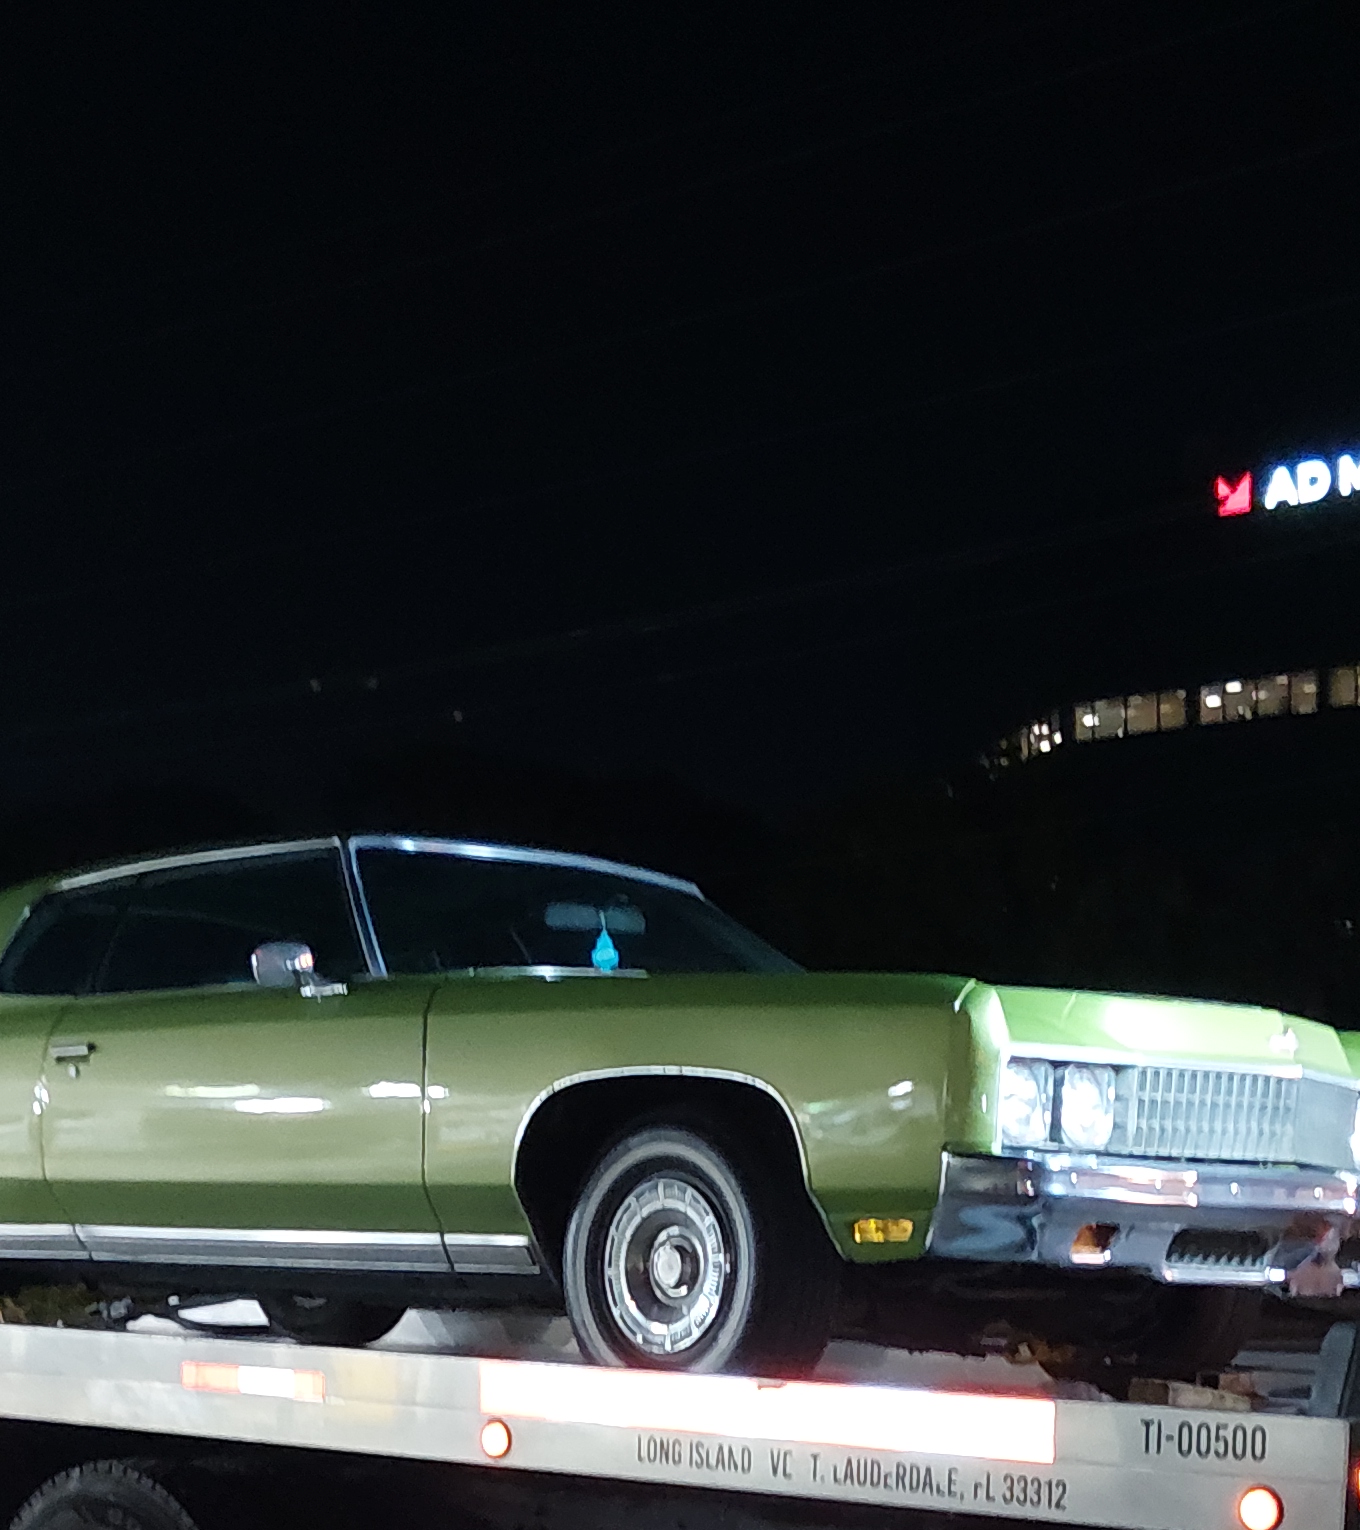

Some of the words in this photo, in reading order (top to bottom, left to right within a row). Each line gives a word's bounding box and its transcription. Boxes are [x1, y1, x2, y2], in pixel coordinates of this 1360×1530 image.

[1263, 458, 1332, 511] AD
[1140, 1417, 1267, 1462] TI-00500
[637, 1433, 683, 1467] LONG
[688, 1438, 752, 1475] ISLAND
[1002, 1472, 1068, 1512] 33312
